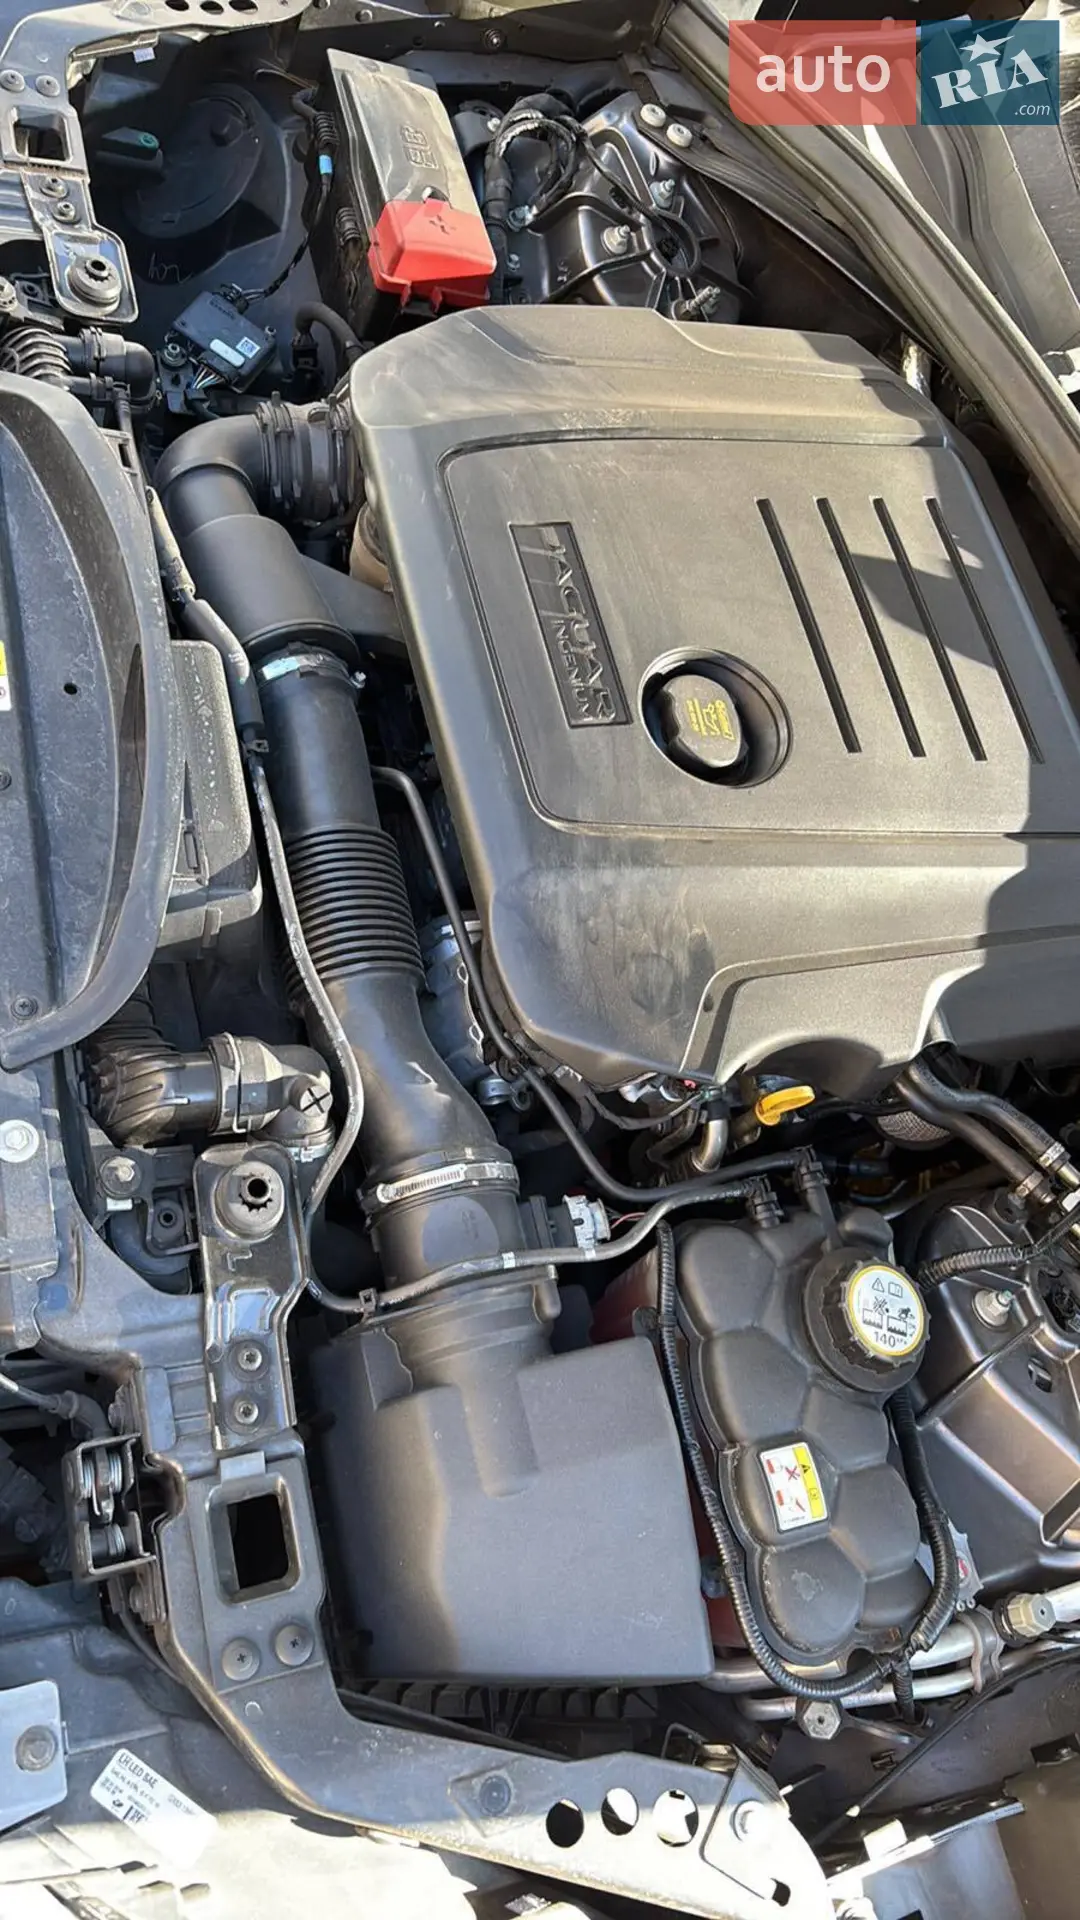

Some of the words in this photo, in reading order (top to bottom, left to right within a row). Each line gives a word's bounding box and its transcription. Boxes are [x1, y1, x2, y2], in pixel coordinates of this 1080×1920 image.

[549, 543, 616, 721] JAGUAR
[552, 619, 594, 721] INGENIUM
[873, 1331, 896, 1348] 140
